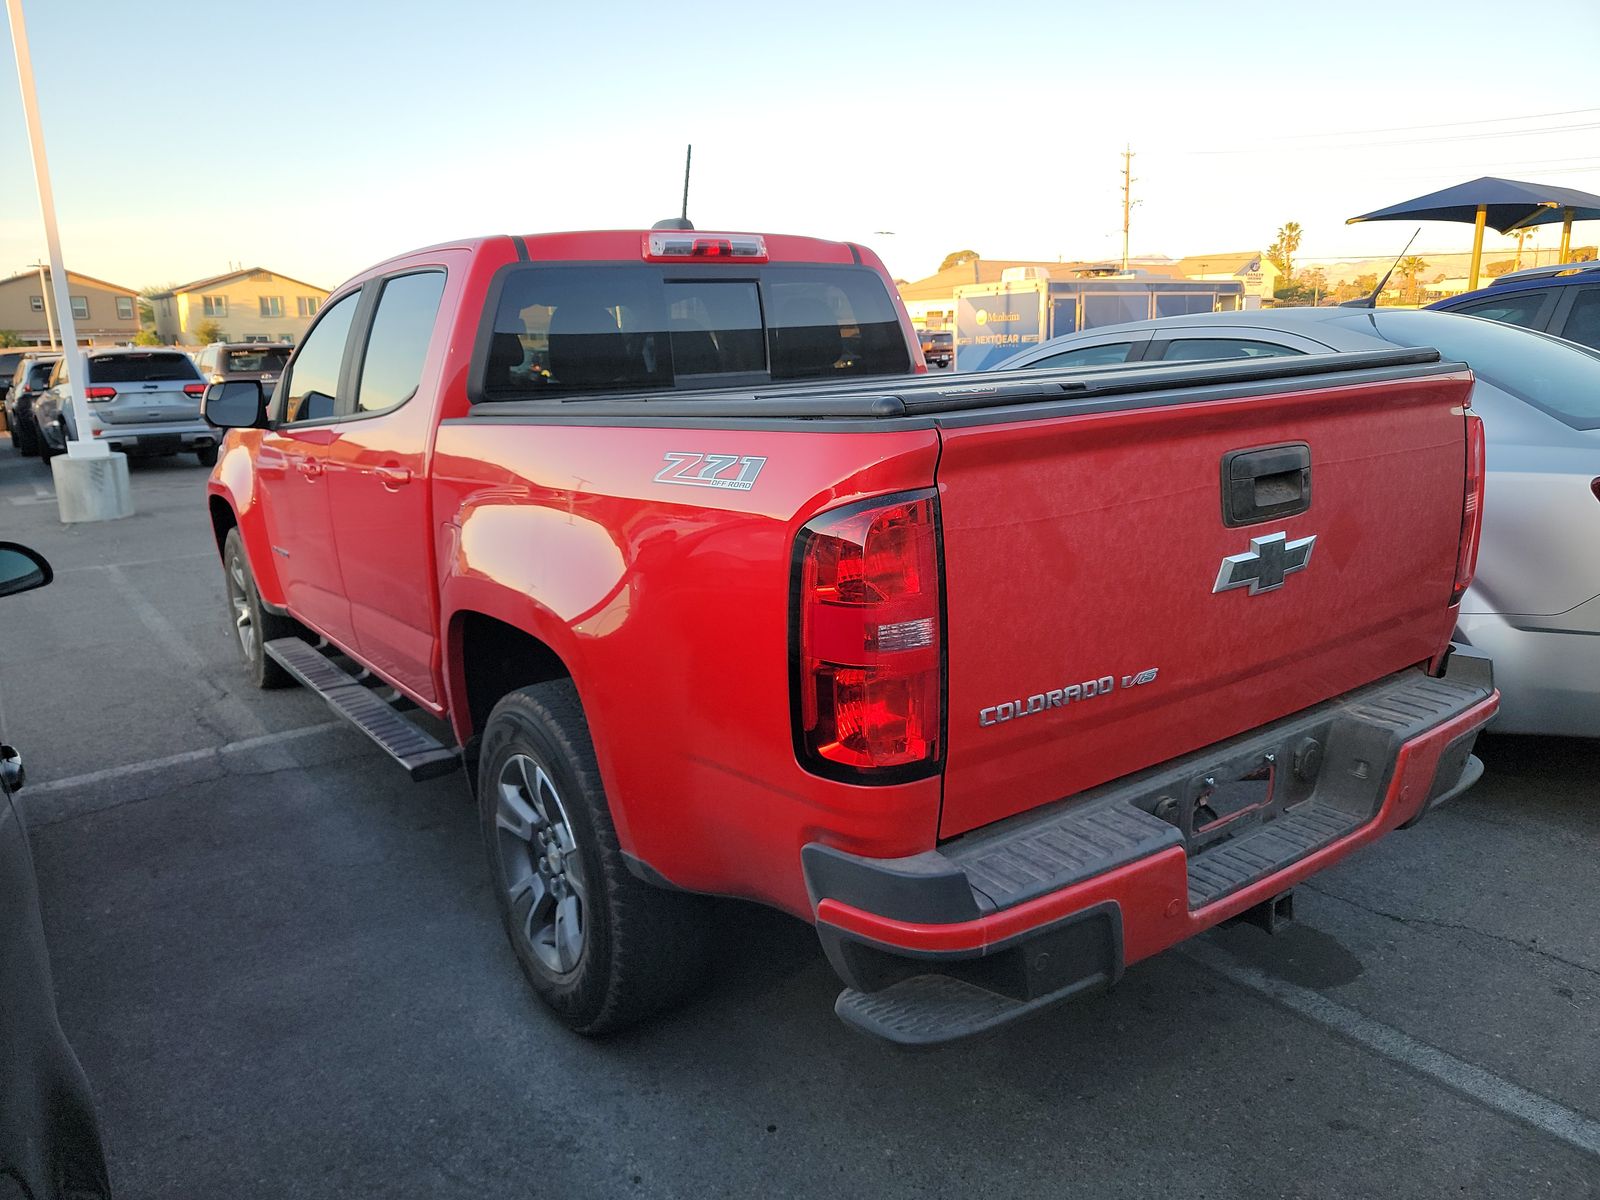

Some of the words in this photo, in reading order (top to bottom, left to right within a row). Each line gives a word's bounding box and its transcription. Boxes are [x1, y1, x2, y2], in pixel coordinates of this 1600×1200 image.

[653, 452, 768, 488] Z71
[728, 481, 751, 489] ROAD
[979, 675, 1114, 727] COLORADO
[1121, 667, 1159, 688] V6
